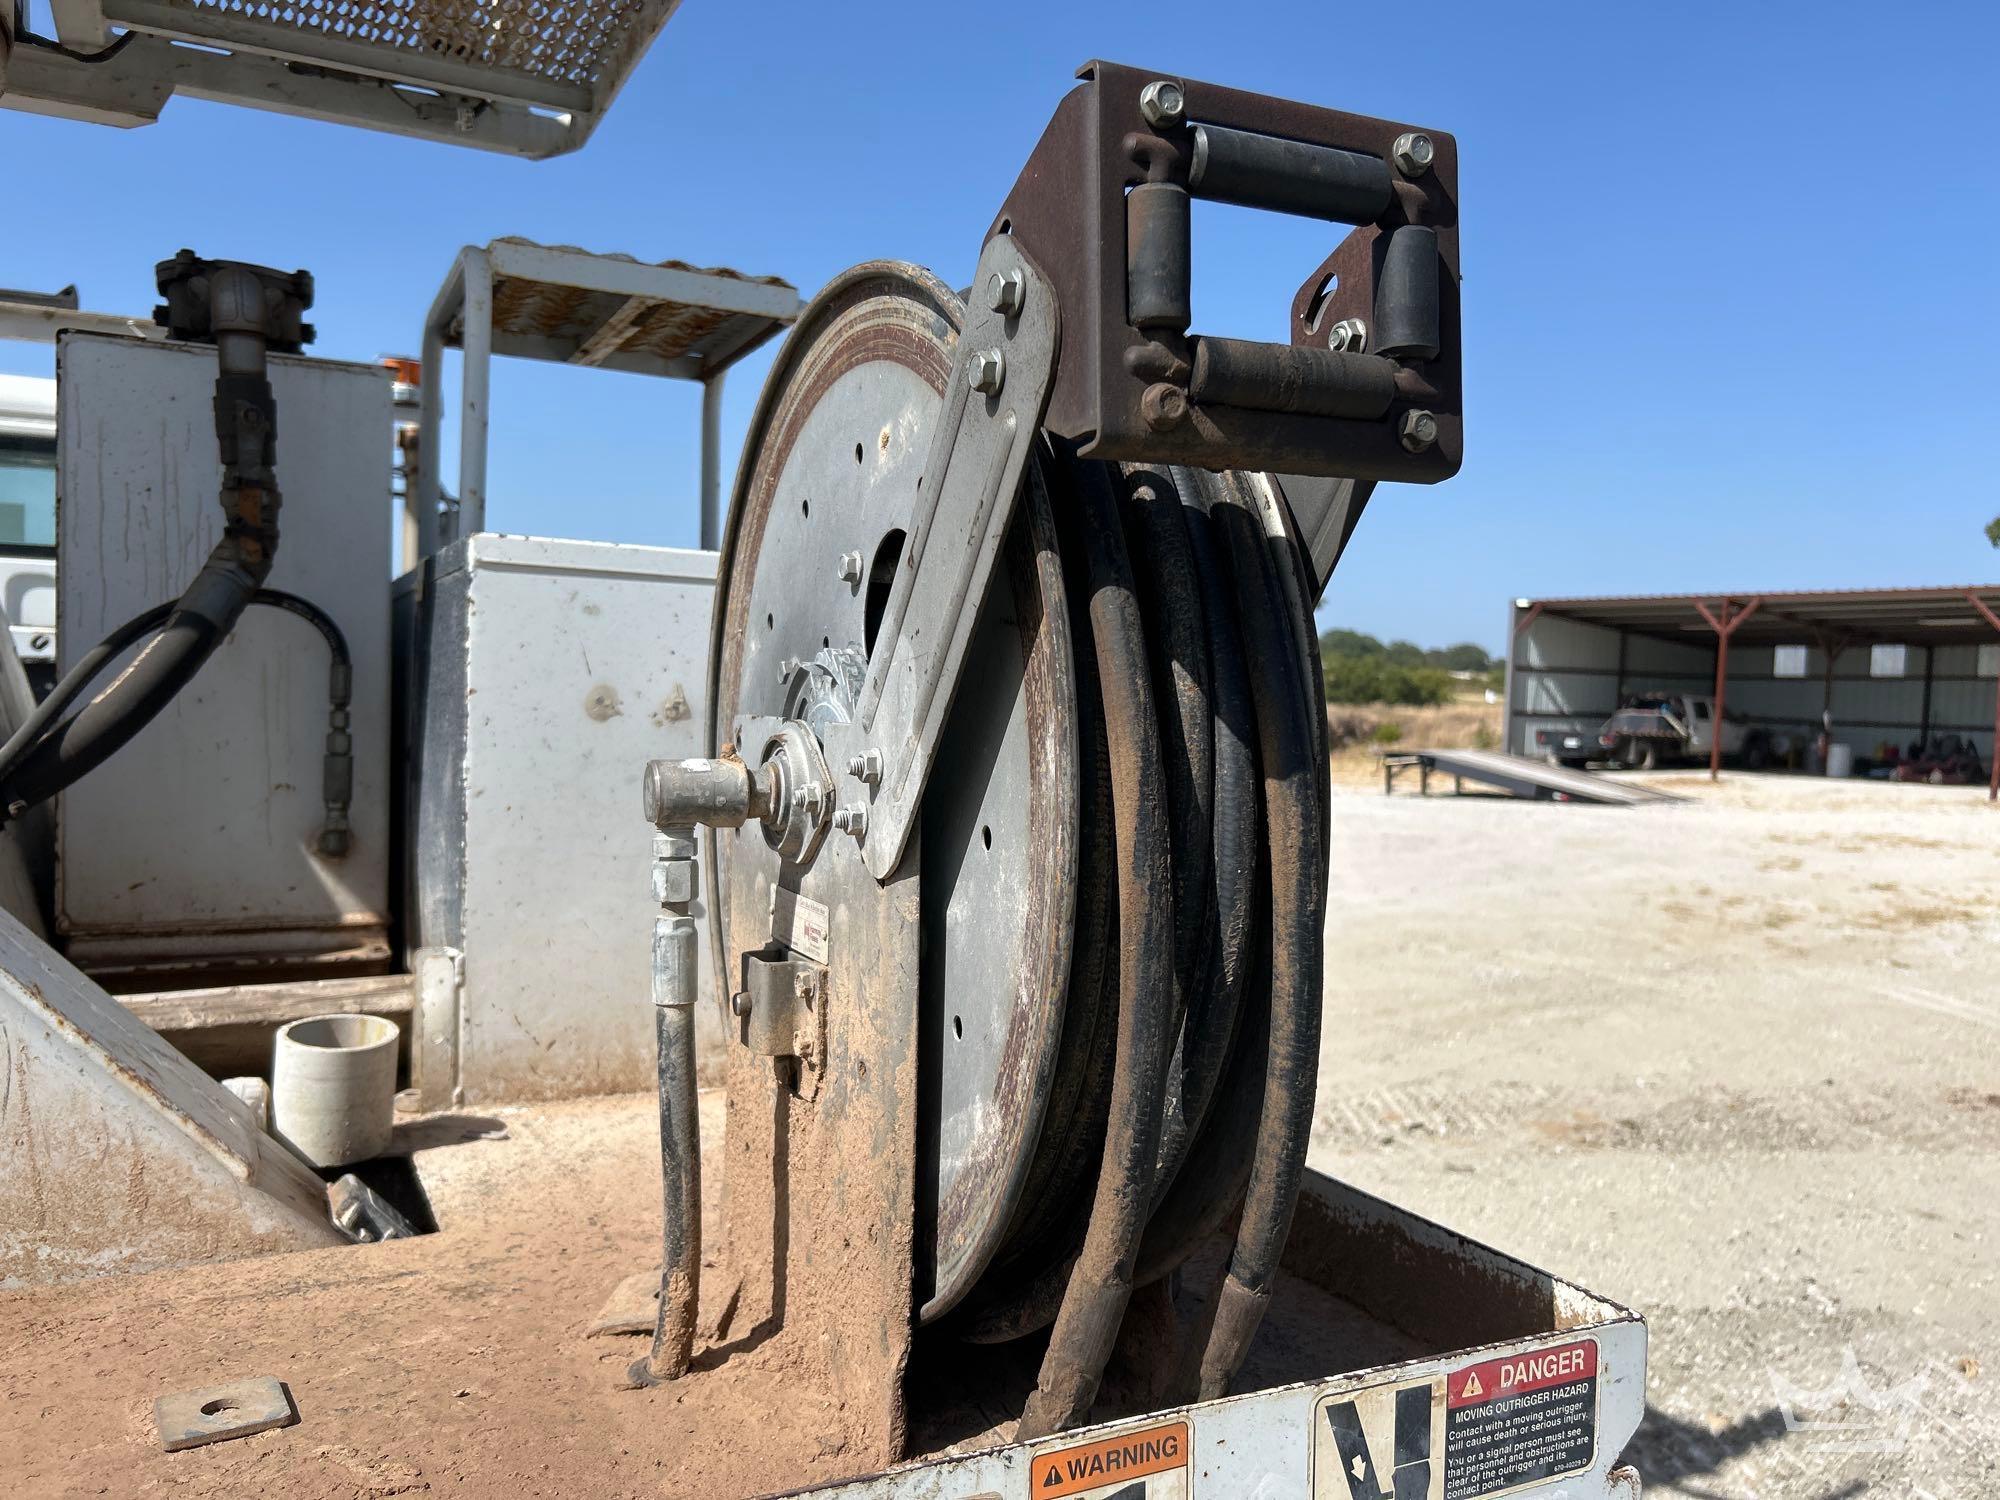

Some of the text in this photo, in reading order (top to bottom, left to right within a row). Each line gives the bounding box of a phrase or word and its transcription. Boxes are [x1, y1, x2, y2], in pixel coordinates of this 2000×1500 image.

[1500, 1348, 1585, 1388] DANGER
[1448, 1401, 1583, 1441] Contact with a moving outrigger
[1455, 1382, 1589, 1424] MOVING OUTRIGGER HAZARD
[1447, 1427, 1582, 1468] You or a signal person must see
[1448, 1411, 1589, 1452] will cause death or serious injury.
[1066, 1435, 1178, 1481] WARNING
[1447, 1435, 1589, 1479] that personnel and obstructions are
[1447, 1451, 1567, 1489] clear of the outrigger and its
[1446, 1476, 1506, 1500] contact point.
